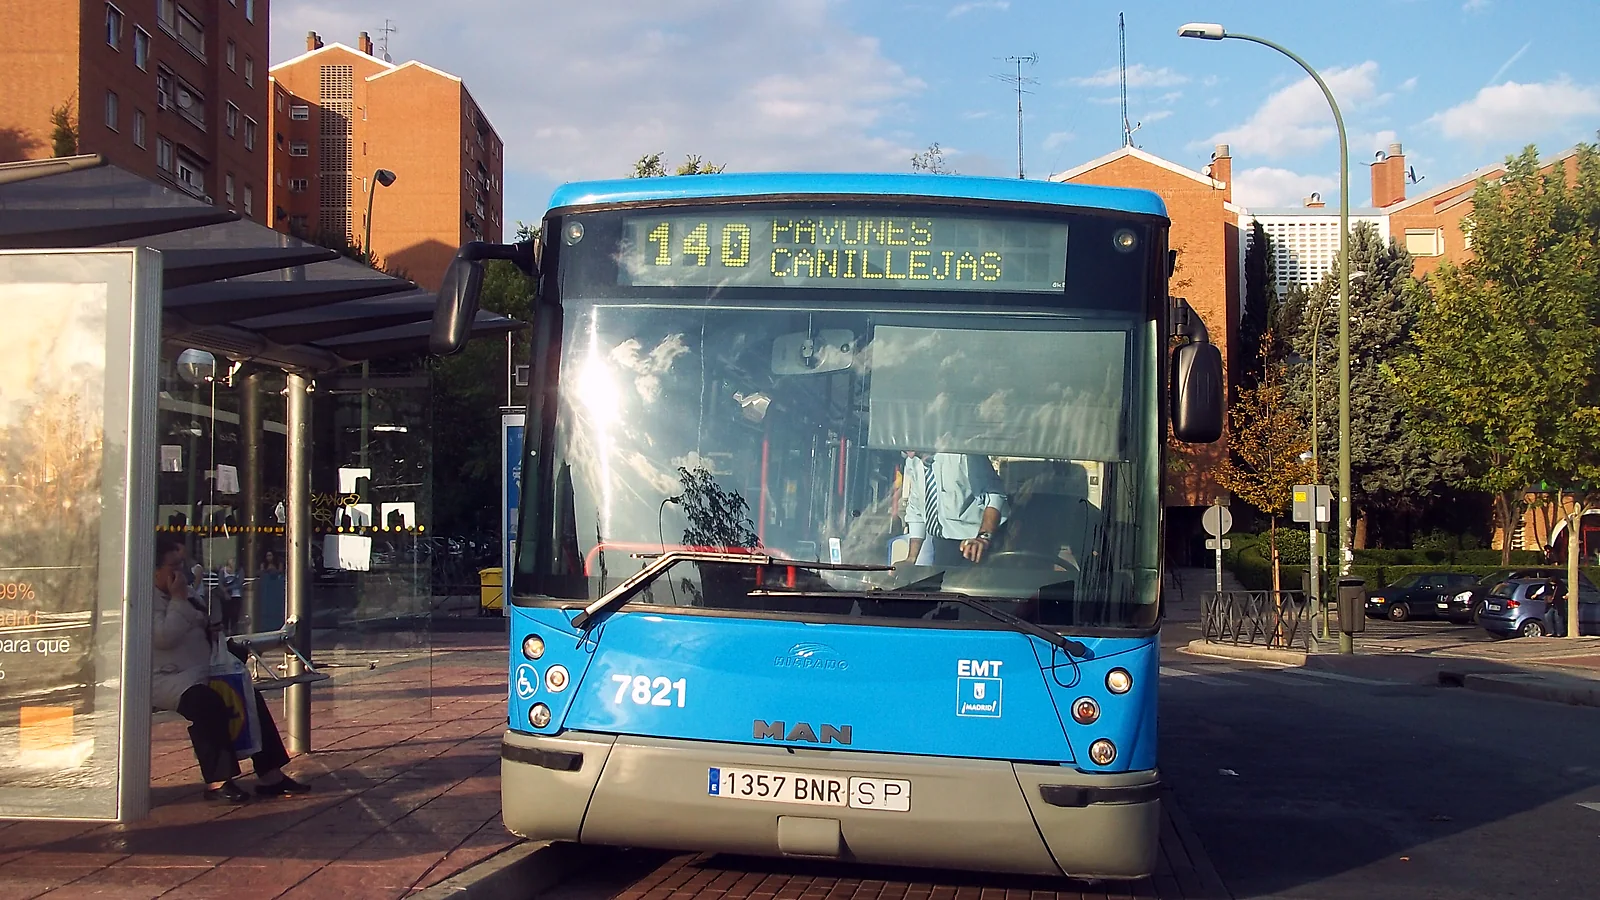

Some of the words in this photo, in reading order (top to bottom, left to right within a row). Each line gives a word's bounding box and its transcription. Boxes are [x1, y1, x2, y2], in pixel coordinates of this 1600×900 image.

[649, 221, 751, 267] 140
[770, 248, 1002, 282] CANILLEJAS
[0, 638, 31, 654] ara
[36, 638, 70, 658] que
[774, 656, 850, 671] HISPANO
[957, 659, 1003, 678] EMT
[611, 673, 687, 708] 7821
[753, 719, 852, 745] MAN
[711, 783, 718, 791] E
[727, 772, 786, 798] 1357
[794, 777, 841, 803] BNR
